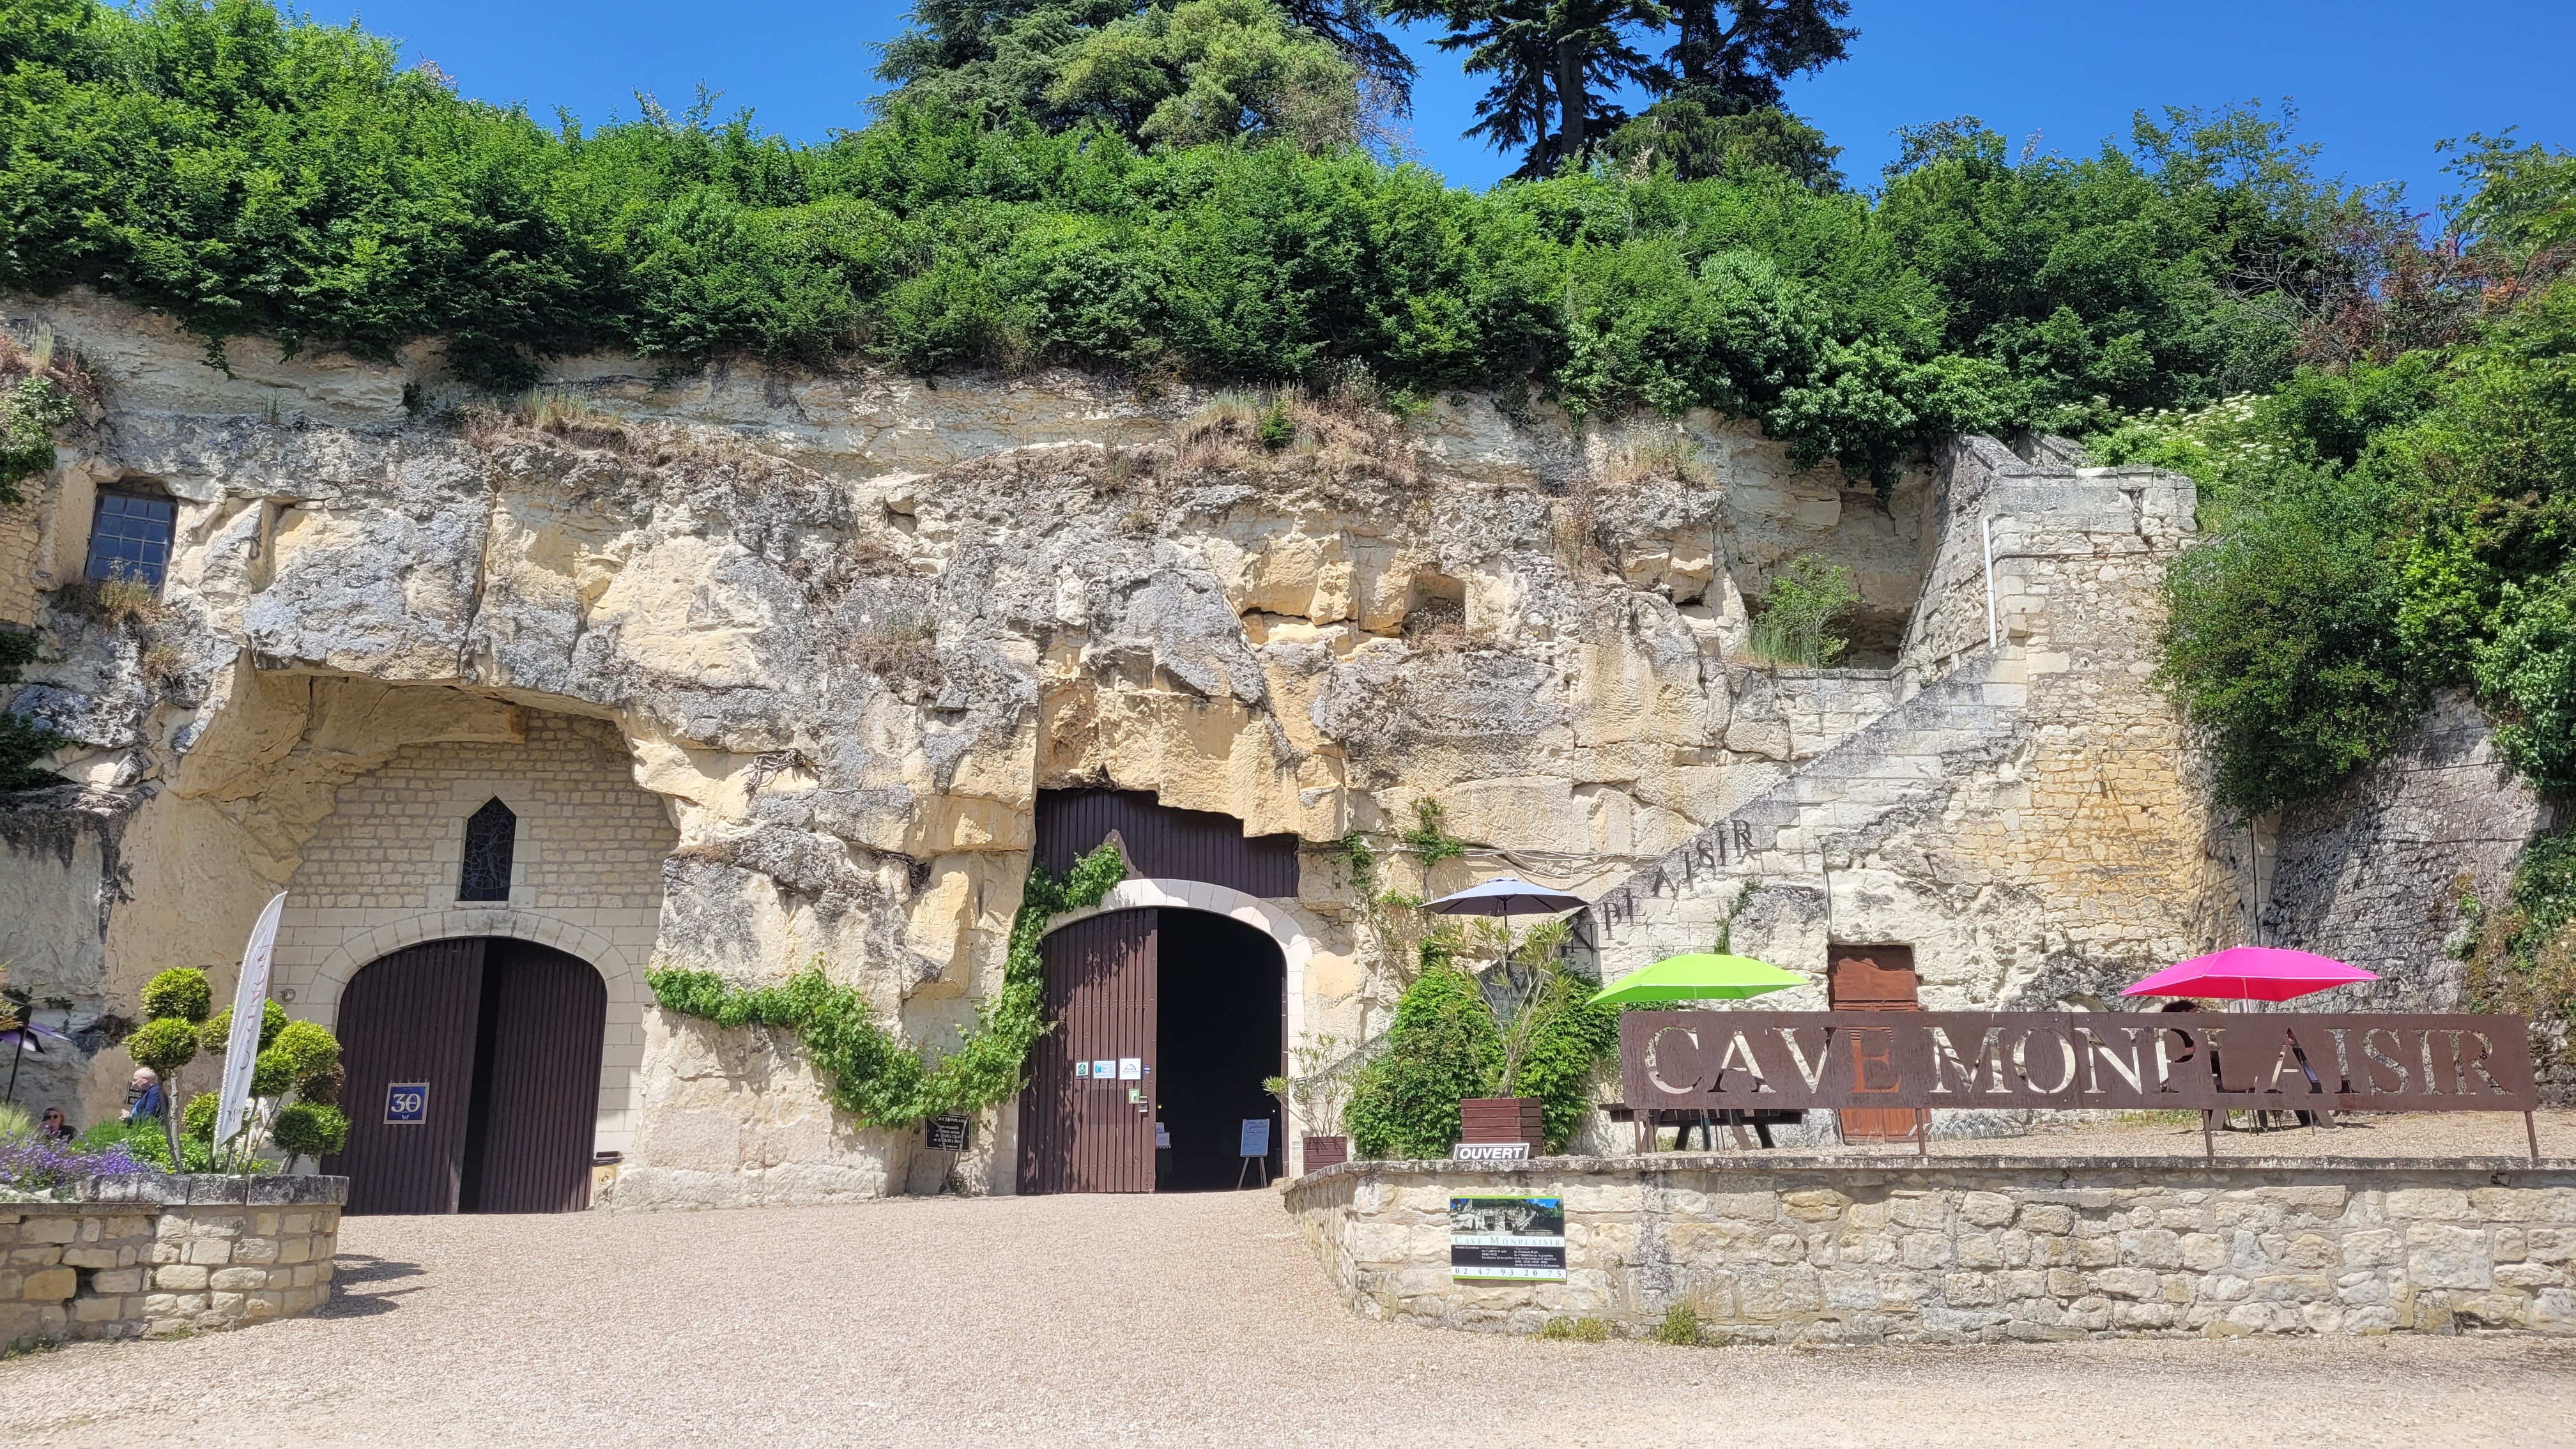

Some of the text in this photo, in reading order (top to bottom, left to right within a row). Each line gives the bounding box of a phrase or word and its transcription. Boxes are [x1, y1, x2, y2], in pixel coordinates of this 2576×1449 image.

[1644, 1026, 2515, 1096] CAVE MONPLAISIR
[391, 1093, 422, 1112] 30
[1459, 1147, 1524, 1160] OUVERT
[1455, 1236, 1560, 1246] CAVE MONPLAISIR
